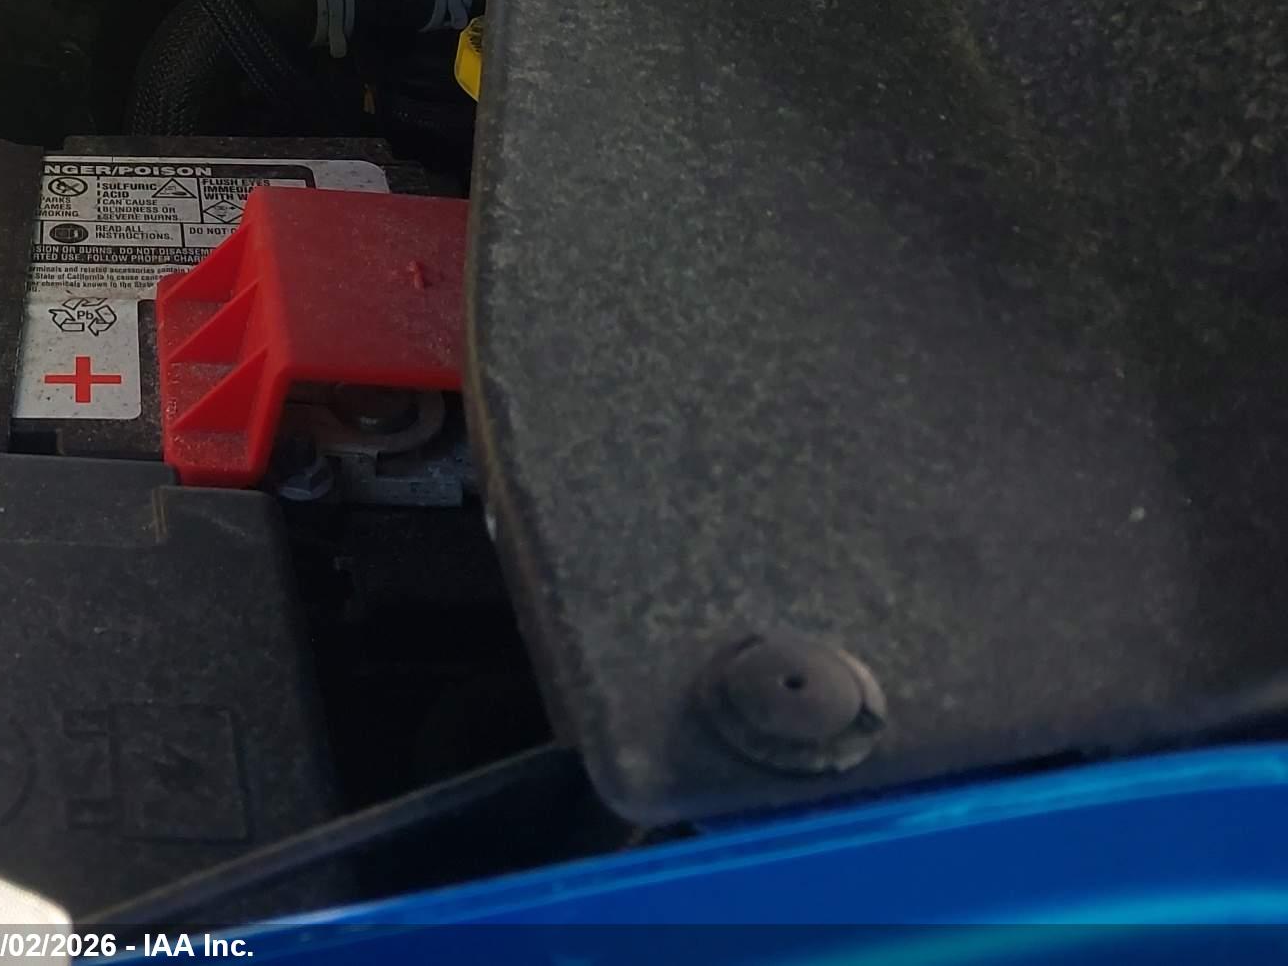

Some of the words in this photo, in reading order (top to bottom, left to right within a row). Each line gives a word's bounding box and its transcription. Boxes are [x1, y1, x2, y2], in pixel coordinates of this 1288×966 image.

[201, 178, 239, 186] FLUSH
[102, 182, 158, 191] SULFURIC
[102, 191, 130, 199] ACID
[204, 193, 234, 201] WITH
[102, 198, 123, 206] CAN
[125, 198, 158, 206] CAUSE
[35, 210, 80, 218] MOKING
[102, 206, 160, 214] BLINDNESS
[163, 206, 176, 214] OR
[95, 224, 123, 232] READ
[124, 225, 144, 233] ALL
[189, 227, 203, 235] DO
[208, 227, 229, 235] NOT
[119, 247, 134, 255] DO
[136, 247, 157, 255] NOT
[87, 254, 128, 263] FOLLOW
[131, 254, 171, 263] PROPER
[66, 273, 105, 281] California
[76, 310, 94, 320] Pb
